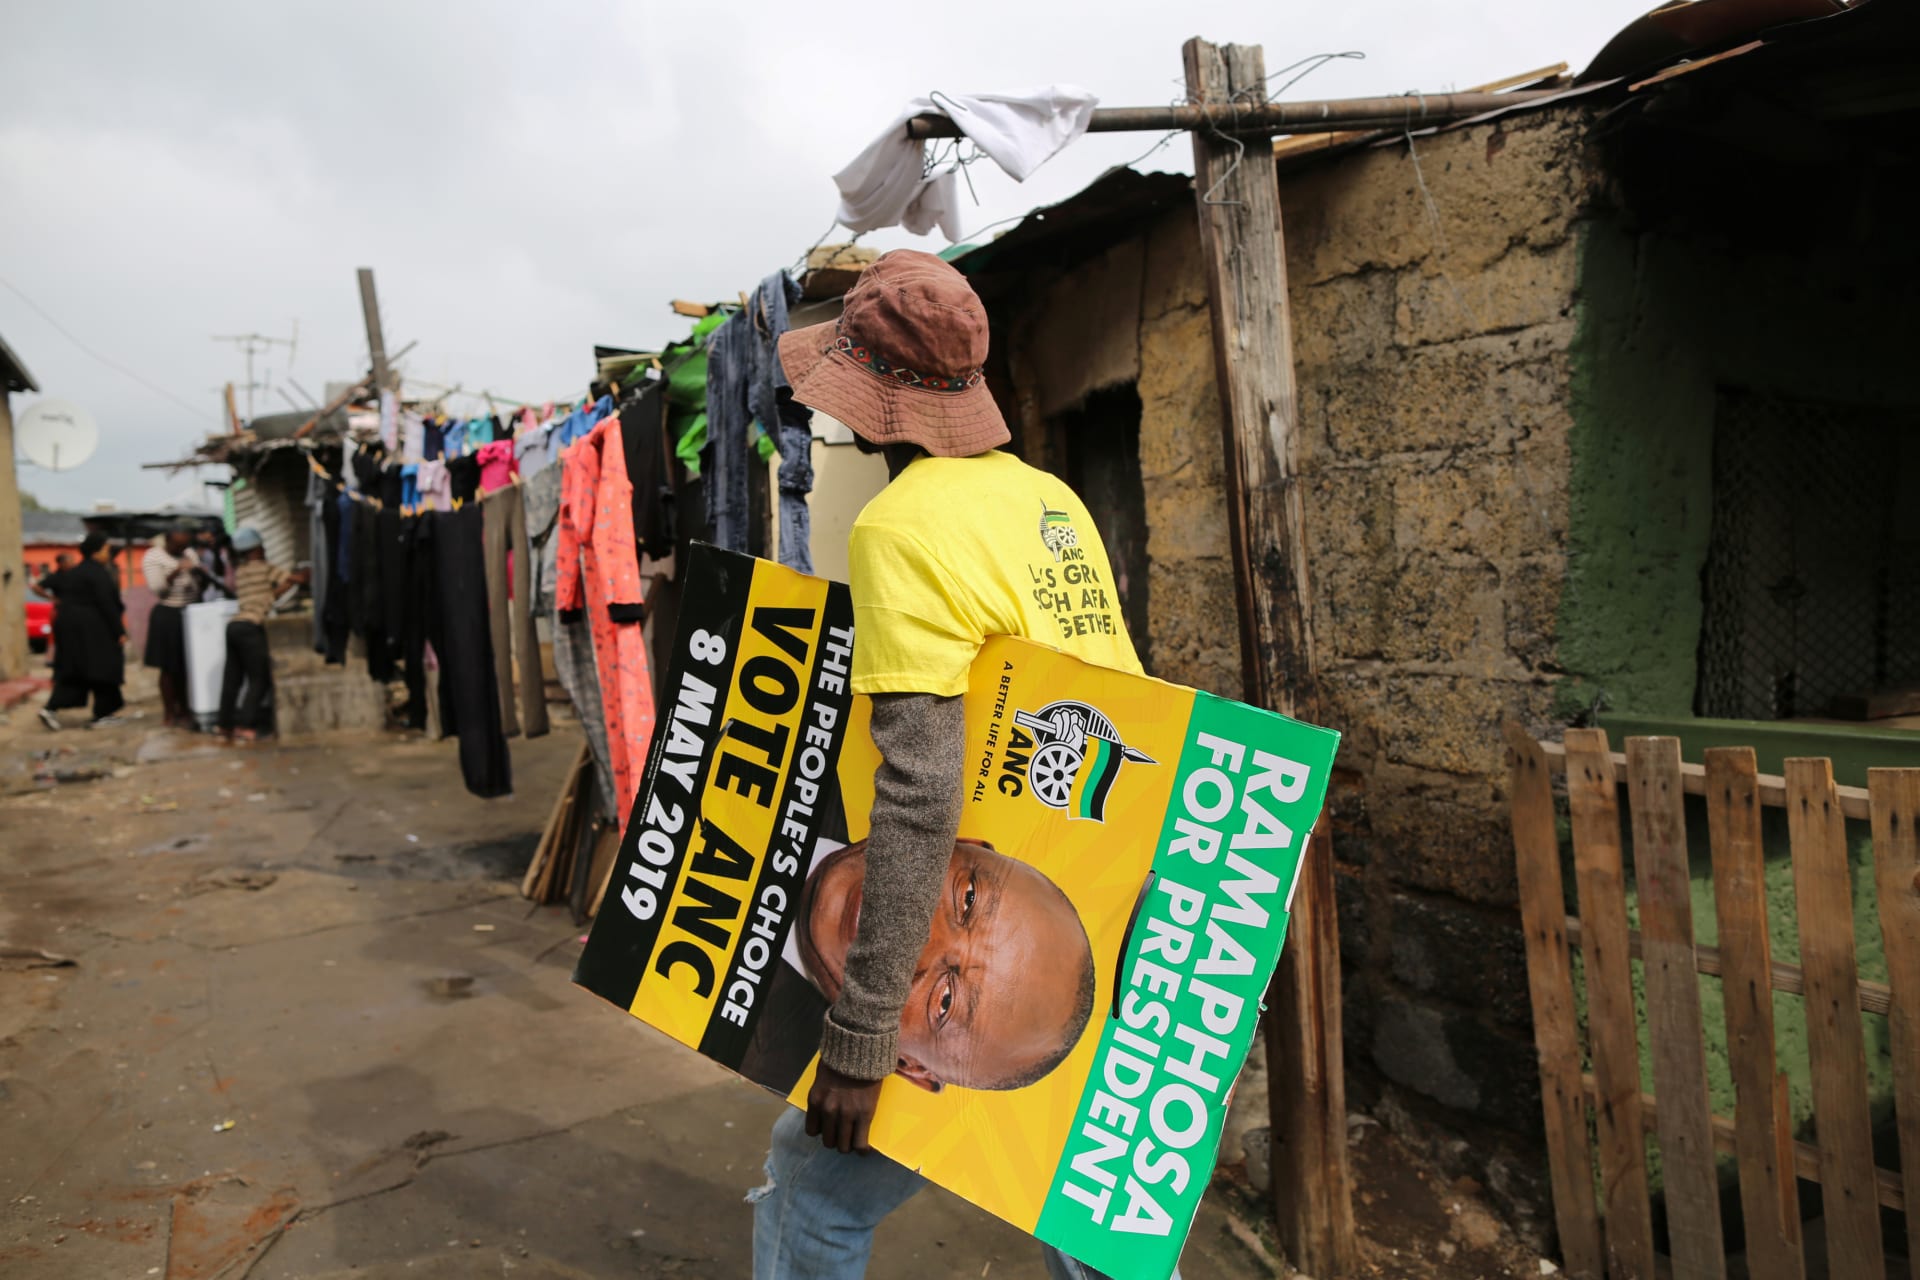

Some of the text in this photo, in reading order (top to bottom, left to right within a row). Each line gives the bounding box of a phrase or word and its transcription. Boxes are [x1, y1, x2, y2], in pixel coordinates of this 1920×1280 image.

[1062, 548, 1084, 562] ANC
[690, 629, 726, 666] 8
[661, 672, 717, 794] MAY
[972, 661, 1013, 802] A BETTER LIFE FOR ALL
[998, 727, 1033, 797] ANC
[620, 796, 684, 921] 2019
[655, 607, 816, 999] VOTE ANC
[721, 625, 855, 1027] THE PEOPLE'S CHOICE
[1061, 731, 1245, 1226] FOR PRESIDENT
[1110, 750, 1311, 1237] RAMAPHOSA
